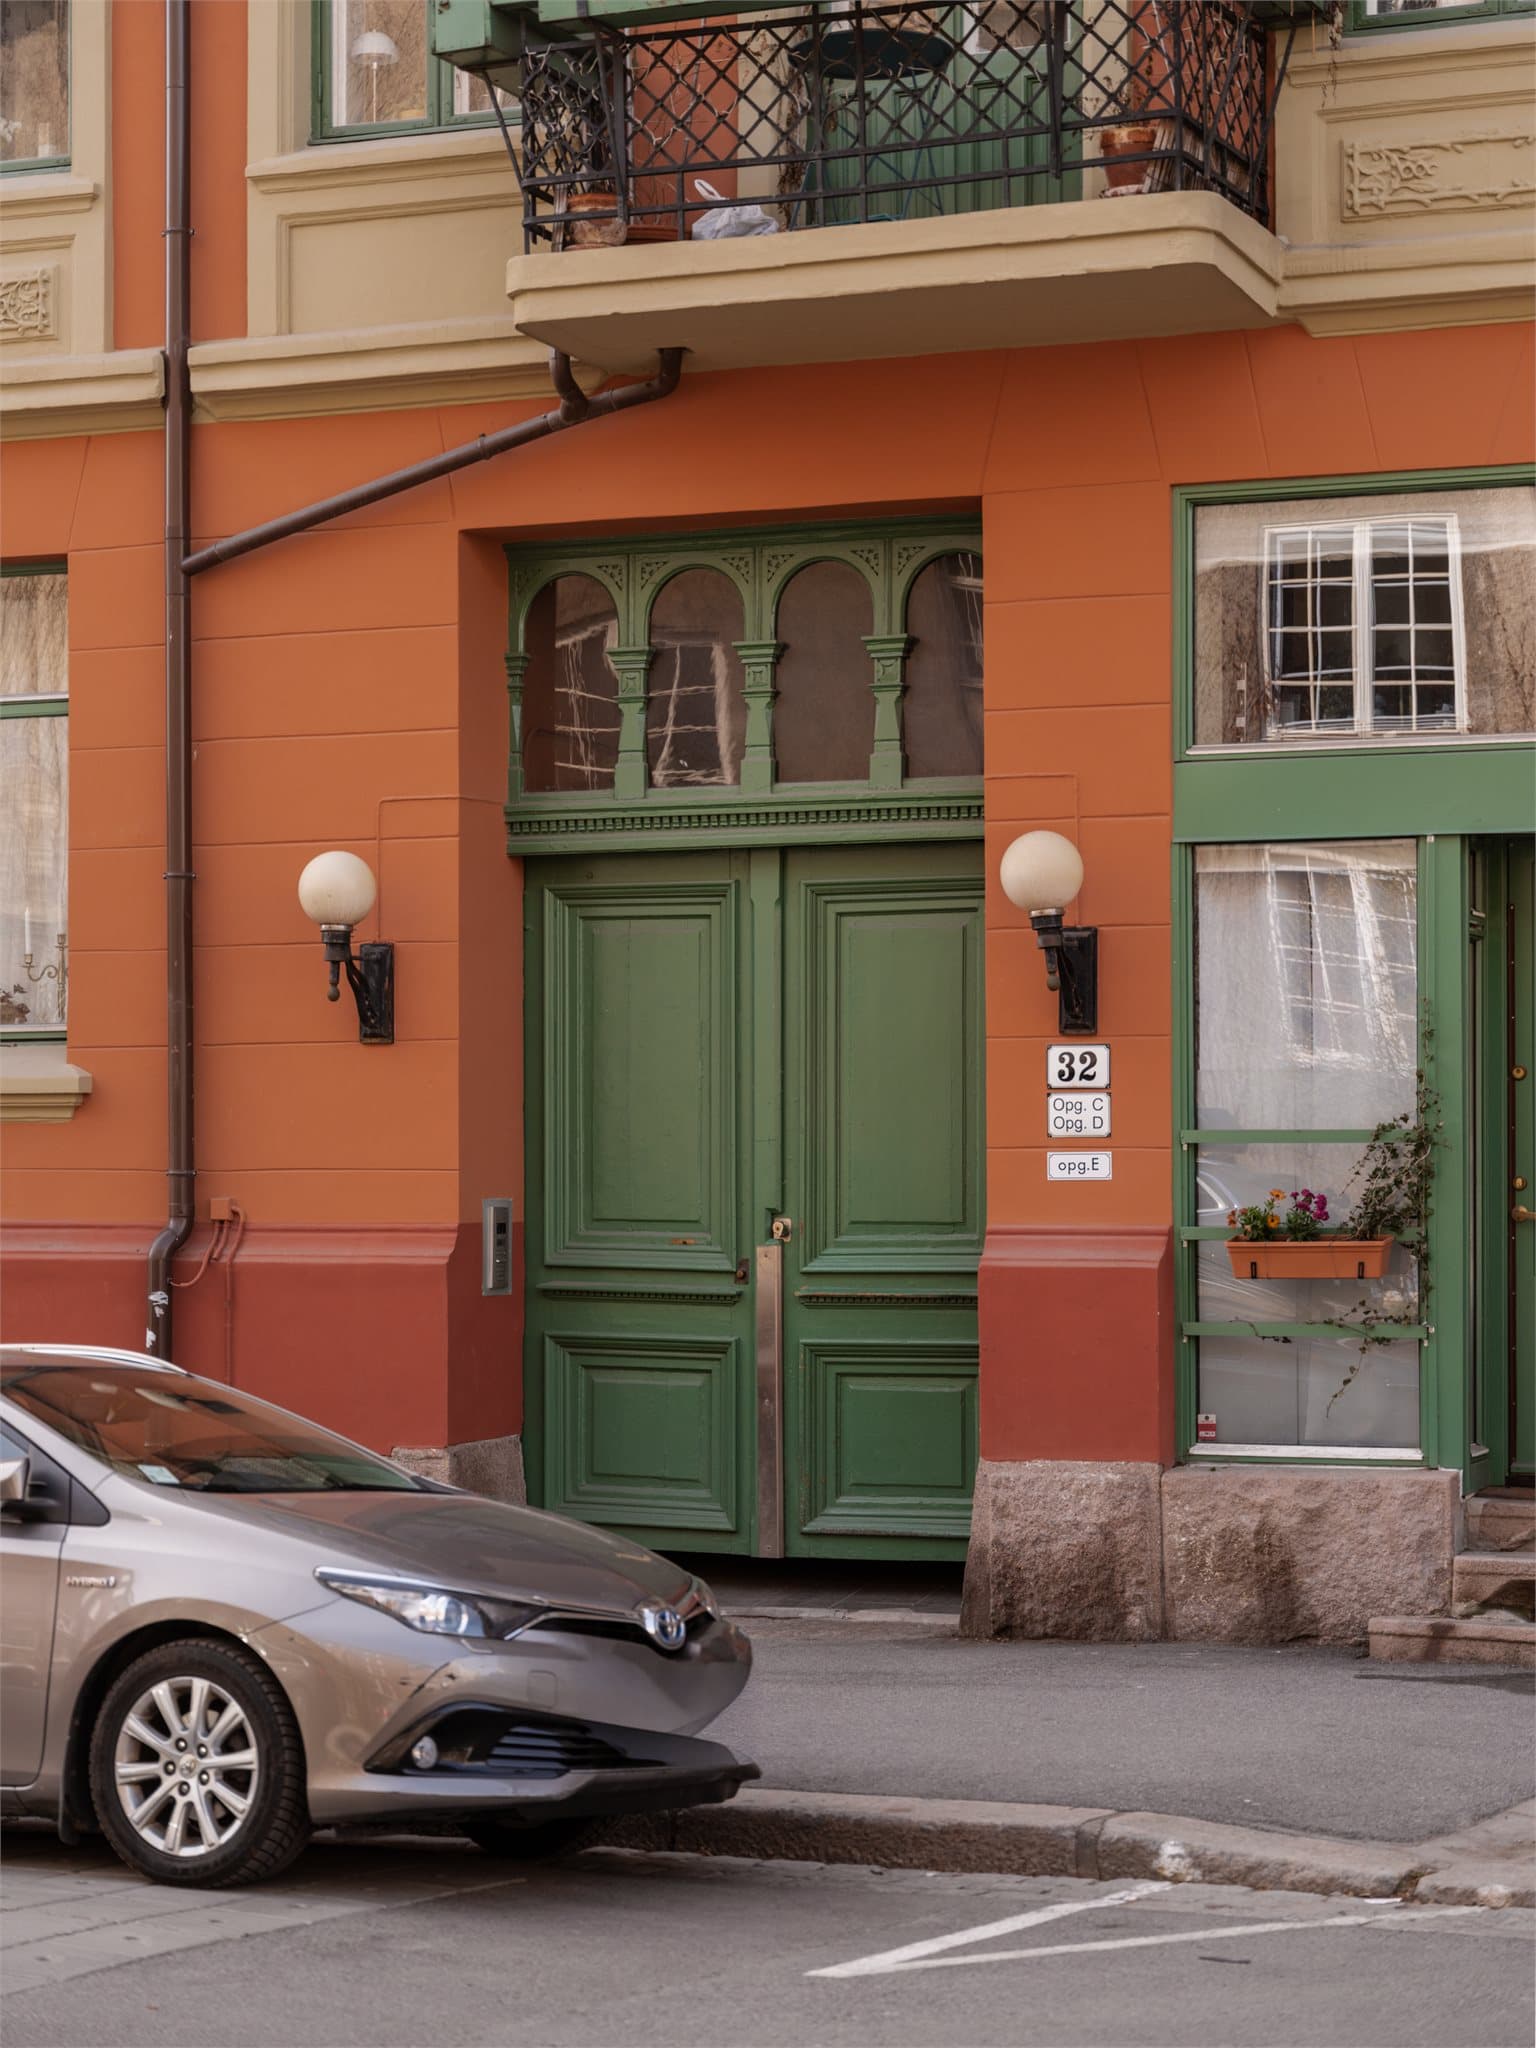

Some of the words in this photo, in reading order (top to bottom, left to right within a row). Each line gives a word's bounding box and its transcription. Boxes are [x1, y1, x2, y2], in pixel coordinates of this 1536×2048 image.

[1057, 1051, 1098, 1082] 32
[1053, 1098, 1087, 1114] Opg.
[1092, 1098, 1104, 1111] C
[1053, 1116, 1087, 1132] Opg.
[1092, 1116, 1104, 1129] D
